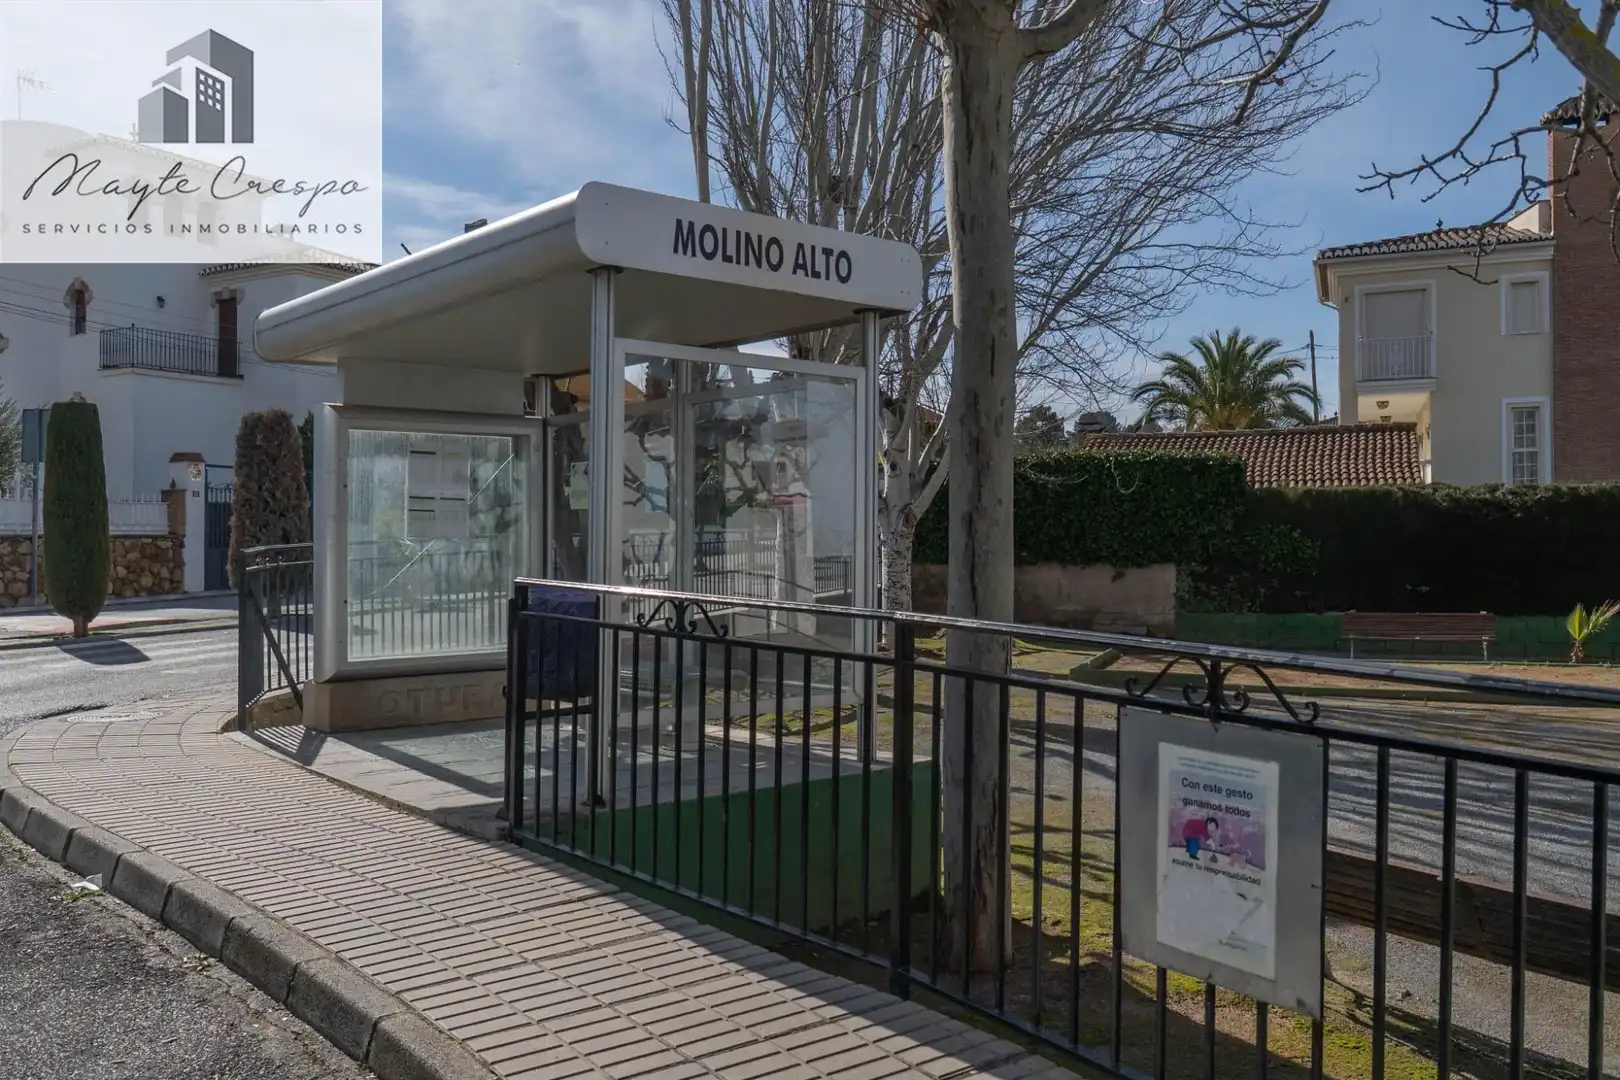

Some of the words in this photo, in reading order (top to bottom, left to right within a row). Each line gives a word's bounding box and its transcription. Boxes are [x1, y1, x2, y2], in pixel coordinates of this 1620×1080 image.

[673, 218, 784, 272] MOLINO
[792, 242, 852, 284] ALTO
[1182, 777, 1200, 790] Con
[1202, 783, 1222, 794] este
[1225, 787, 1253, 800] gesto
[1182, 797, 1222, 812] ganamos
[1225, 804, 1251, 818] todos
